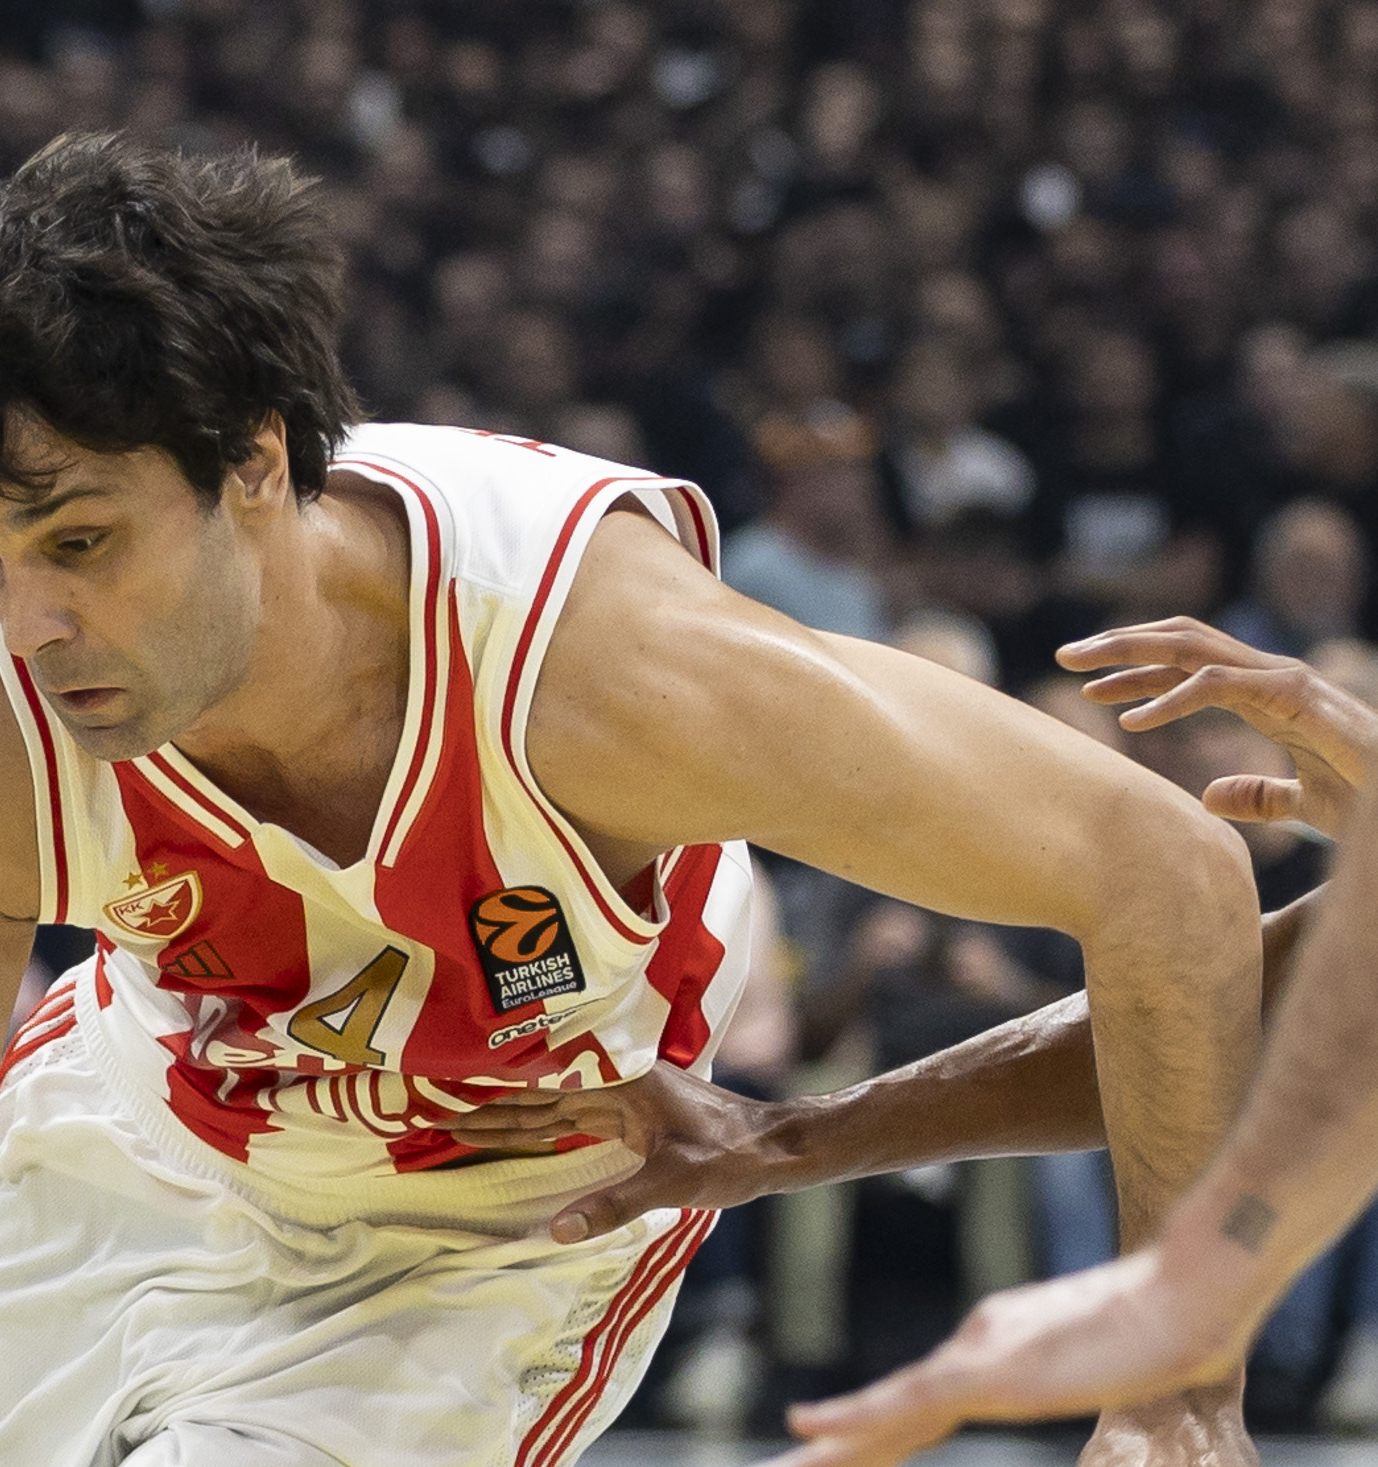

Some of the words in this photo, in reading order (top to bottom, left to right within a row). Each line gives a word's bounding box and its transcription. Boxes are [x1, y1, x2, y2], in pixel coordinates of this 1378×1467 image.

[117, 901, 144, 915] KK
[494, 952, 571, 986] TURKISH
[500, 966, 575, 1000] AIRLINES
[289, 944, 410, 1067] 4
[501, 981, 578, 1010] EuroLeague
